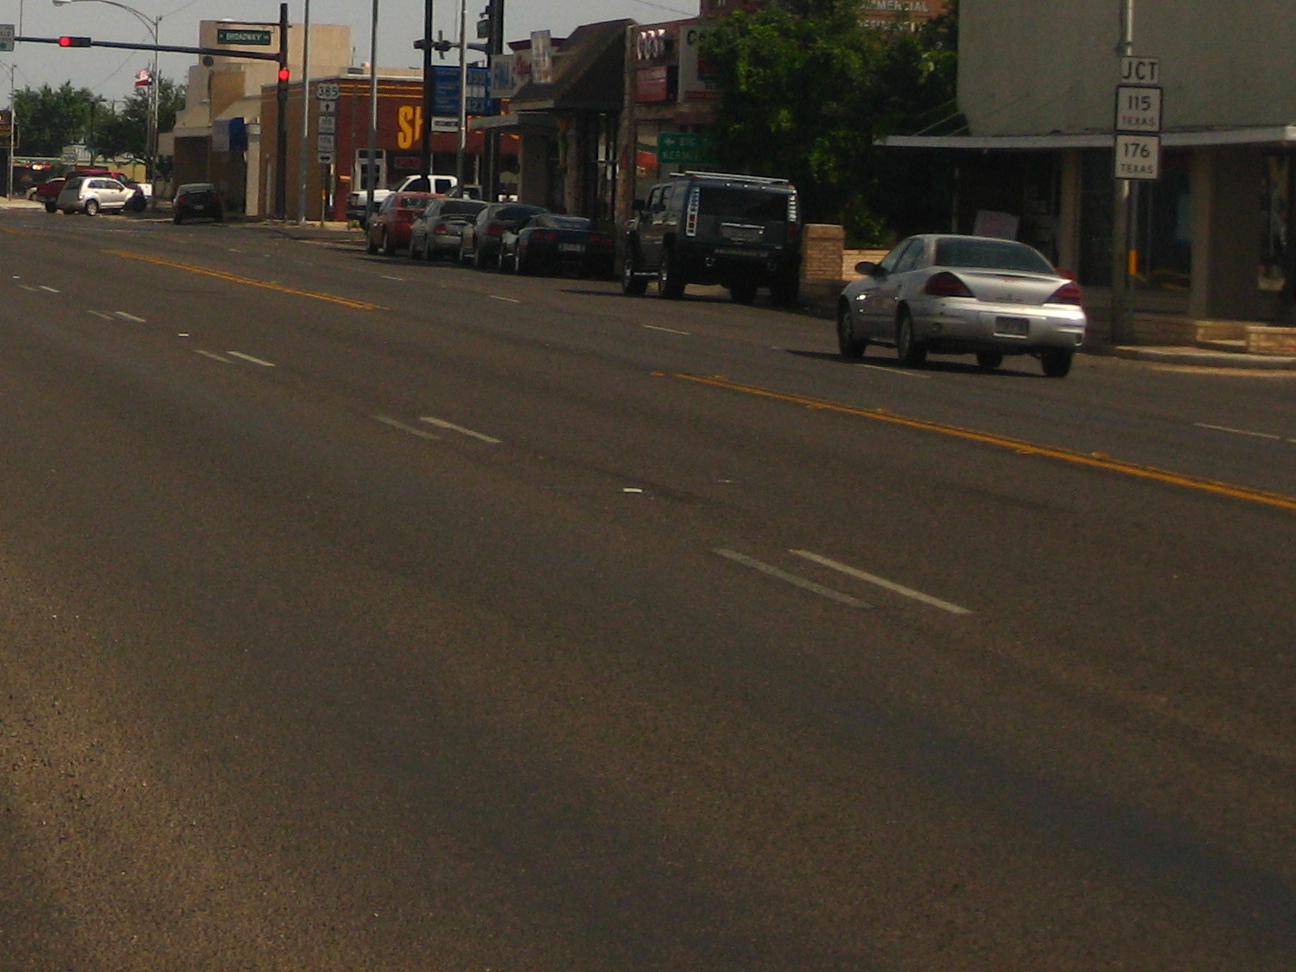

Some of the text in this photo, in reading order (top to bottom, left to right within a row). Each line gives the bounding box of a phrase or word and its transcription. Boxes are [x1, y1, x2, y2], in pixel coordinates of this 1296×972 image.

[226, 31, 262, 42] BROADWAY
[1122, 61, 1158, 80] JCT
[318, 85, 338, 97] 385
[1128, 95, 1151, 111] 115
[1122, 115, 1155, 127] TEXAS
[1124, 142, 1150, 158] 176
[1120, 163, 1153, 174] TEXAS
